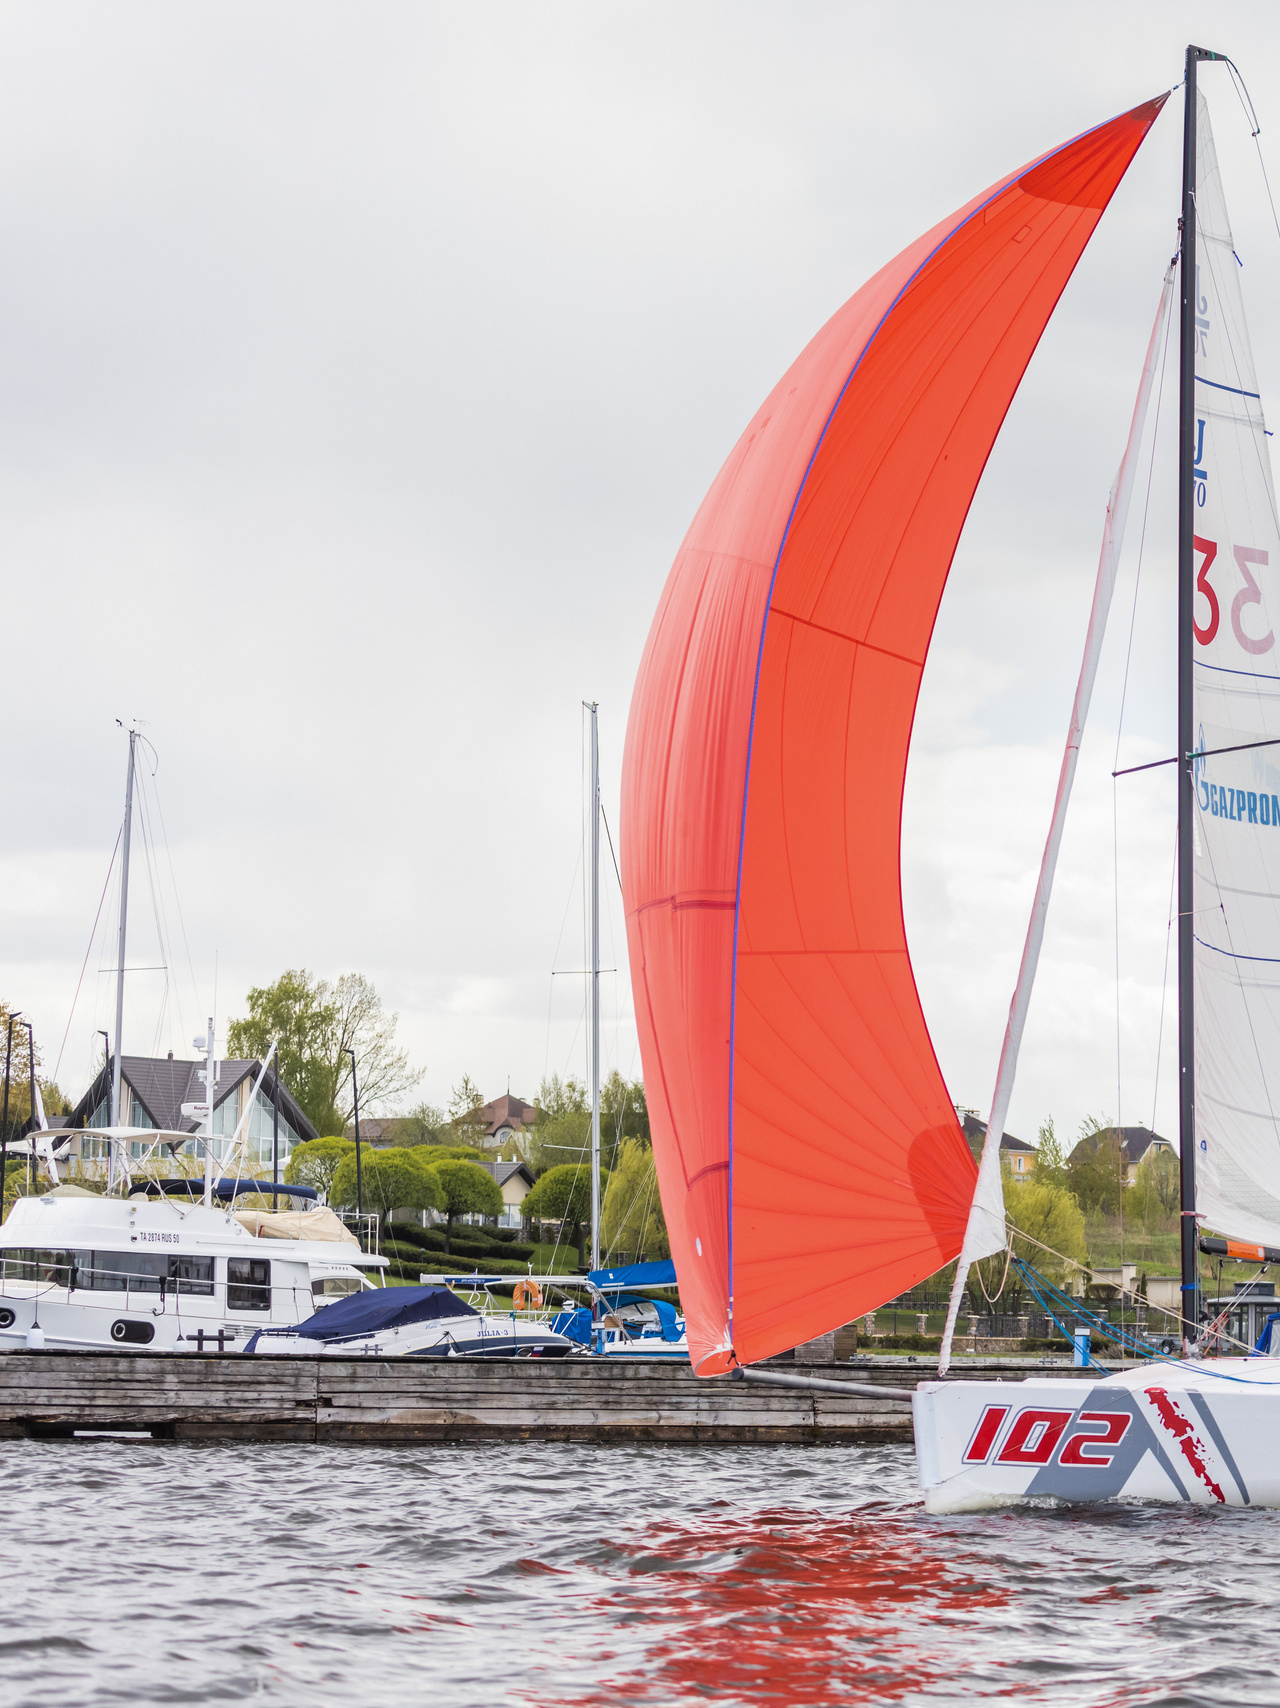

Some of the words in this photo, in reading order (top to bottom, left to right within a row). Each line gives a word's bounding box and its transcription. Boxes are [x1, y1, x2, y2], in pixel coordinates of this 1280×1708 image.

[161, 1233, 172, 1243] RUS
[173, 1234, 180, 1243] 50
[962, 1404, 1133, 1468] 102
